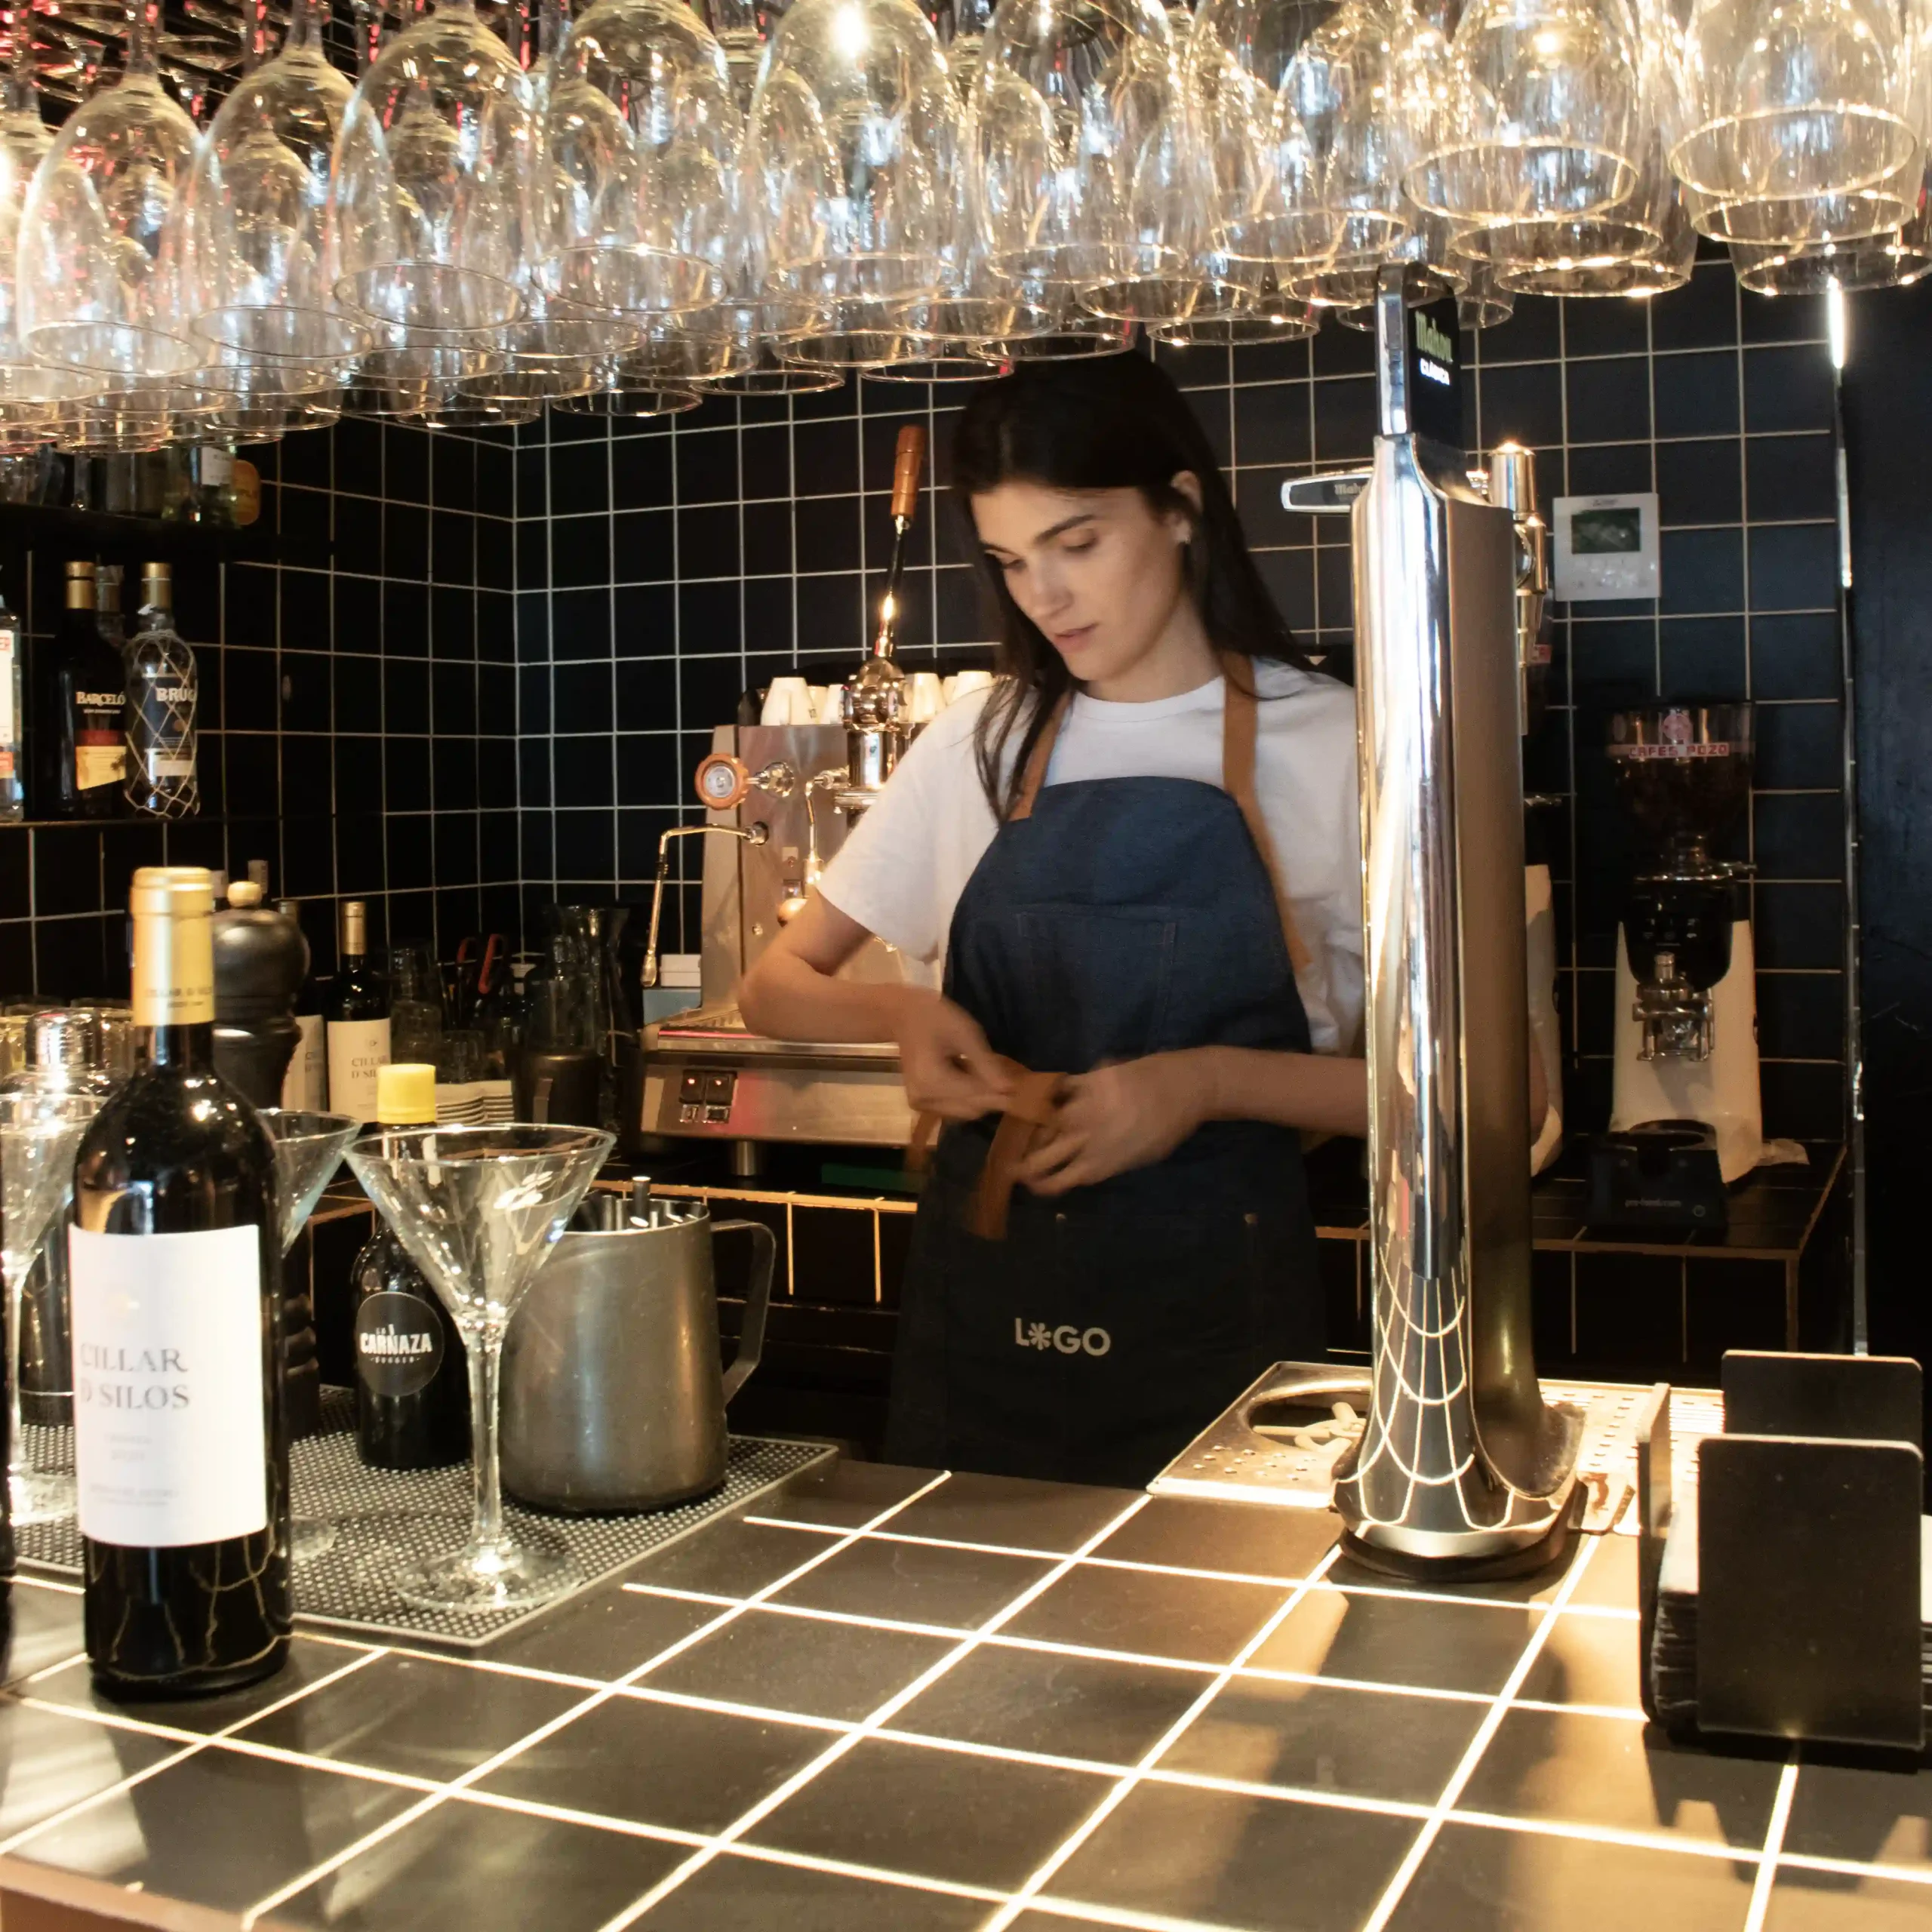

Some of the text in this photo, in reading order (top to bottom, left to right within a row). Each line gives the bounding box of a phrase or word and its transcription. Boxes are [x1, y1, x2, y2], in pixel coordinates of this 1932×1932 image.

[1687, 744, 1727, 755] POZO
[81, 1343, 189, 1373] CILLAR
[99, 1384, 190, 1410] SILOS
